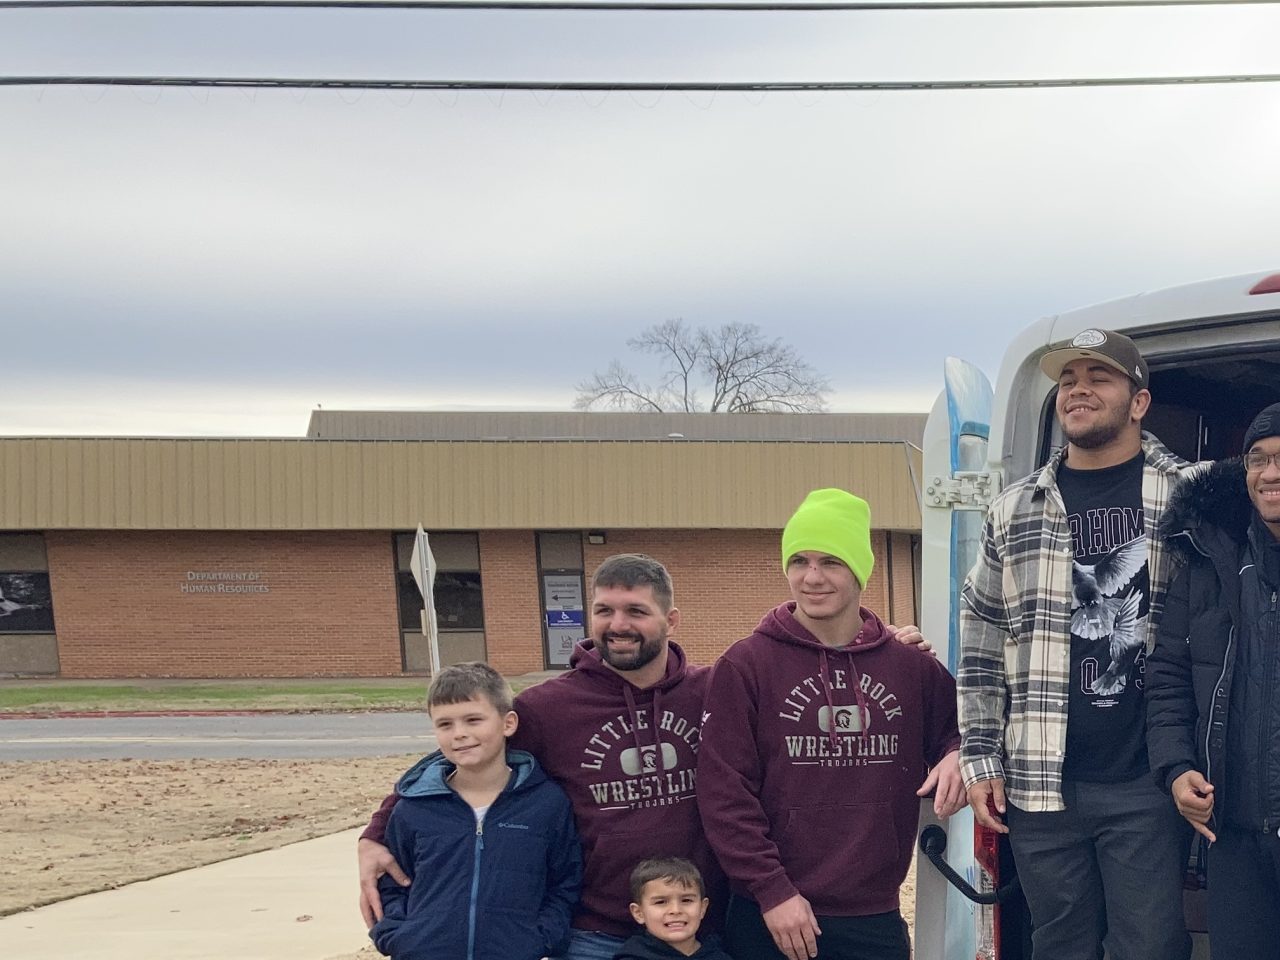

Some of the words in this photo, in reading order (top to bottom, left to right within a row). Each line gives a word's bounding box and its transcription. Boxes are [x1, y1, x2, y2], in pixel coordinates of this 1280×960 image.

[860, 673, 903, 721] ROCK
[581, 710, 648, 770] LITTLE
[785, 734, 899, 757] WRESTLING
[820, 759, 867, 767] TROJANS
[588, 768, 697, 804] WRESTLIN
[630, 798, 680, 810] TROJANS
